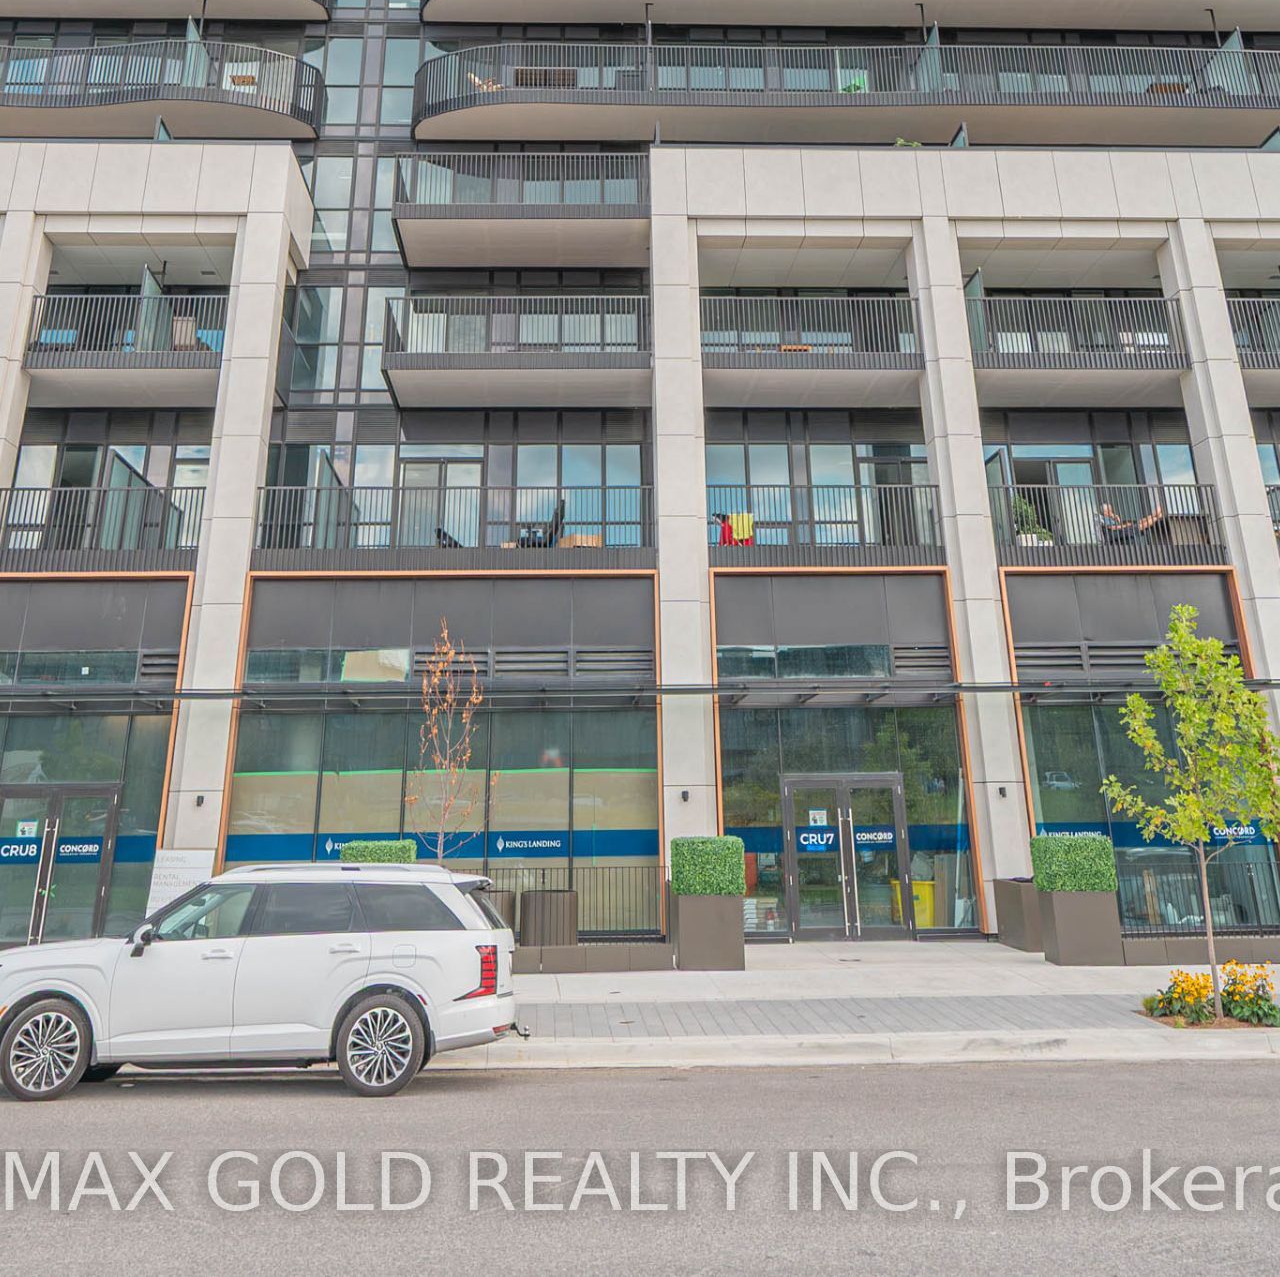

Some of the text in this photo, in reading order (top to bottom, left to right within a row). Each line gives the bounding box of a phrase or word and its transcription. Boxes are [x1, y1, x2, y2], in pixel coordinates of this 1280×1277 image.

[1213, 826, 1256, 836] CONCORD
[800, 833, 834, 845] CRU7
[855, 832, 893, 841] CONCORD
[528, 839, 561, 848] LANDING
[0, 844, 38, 857] CRU8
[59, 844, 100, 853] CONCORD
